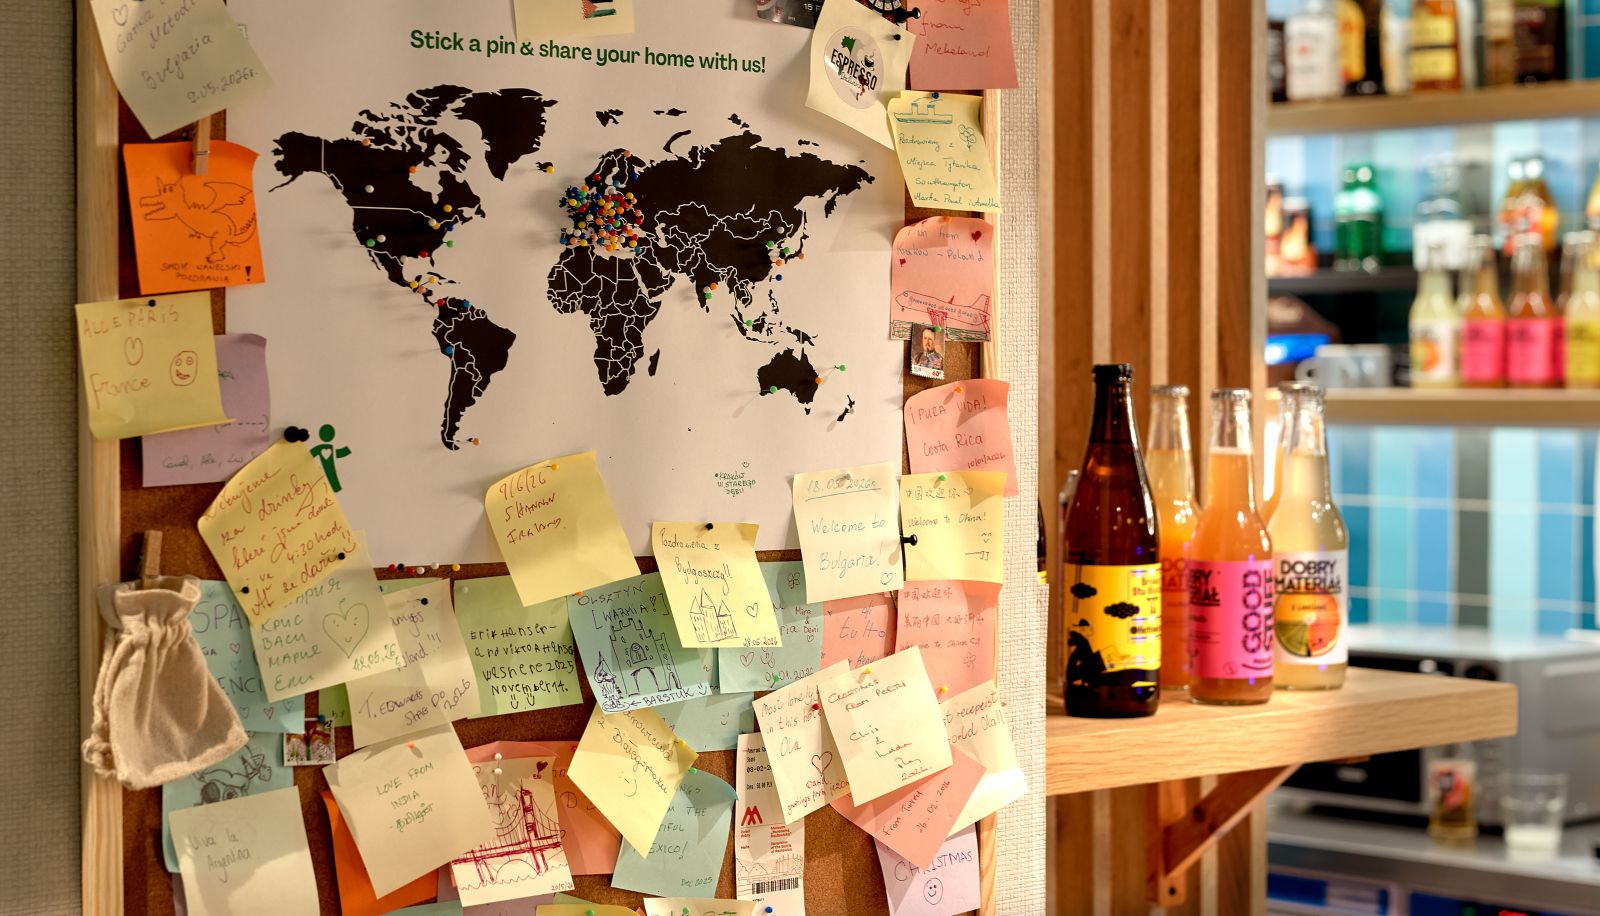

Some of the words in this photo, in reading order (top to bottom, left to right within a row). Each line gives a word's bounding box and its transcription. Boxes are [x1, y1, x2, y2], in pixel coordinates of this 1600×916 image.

[410, 29, 464, 51] Stick
[469, 39, 482, 53] a
[487, 35, 515, 58] pin
[520, 42, 535, 57] &
[539, 40, 592, 61] share
[596, 48, 640, 66] your
[644, 47, 695, 68] home
[699, 52, 737, 72] with
[742, 56, 766, 73] us!
[831, 48, 877, 91] ESPRESSO
[923, 441, 948, 457] Costa
[955, 433, 984, 447] Rica
[811, 517, 865, 534] Welcome
[872, 513, 886, 529] to
[1281, 560, 1337, 575] DOBRY
[577, 581, 645, 606] OLSZTYN
[1242, 570, 1262, 653] GOOD
[643, 689, 694, 706] BARSTUK
[376, 776, 402, 795] LOVE
[408, 762, 434, 780] FROM
[687, 807, 707, 816] THE
[648, 842, 688, 860] EXICO!
